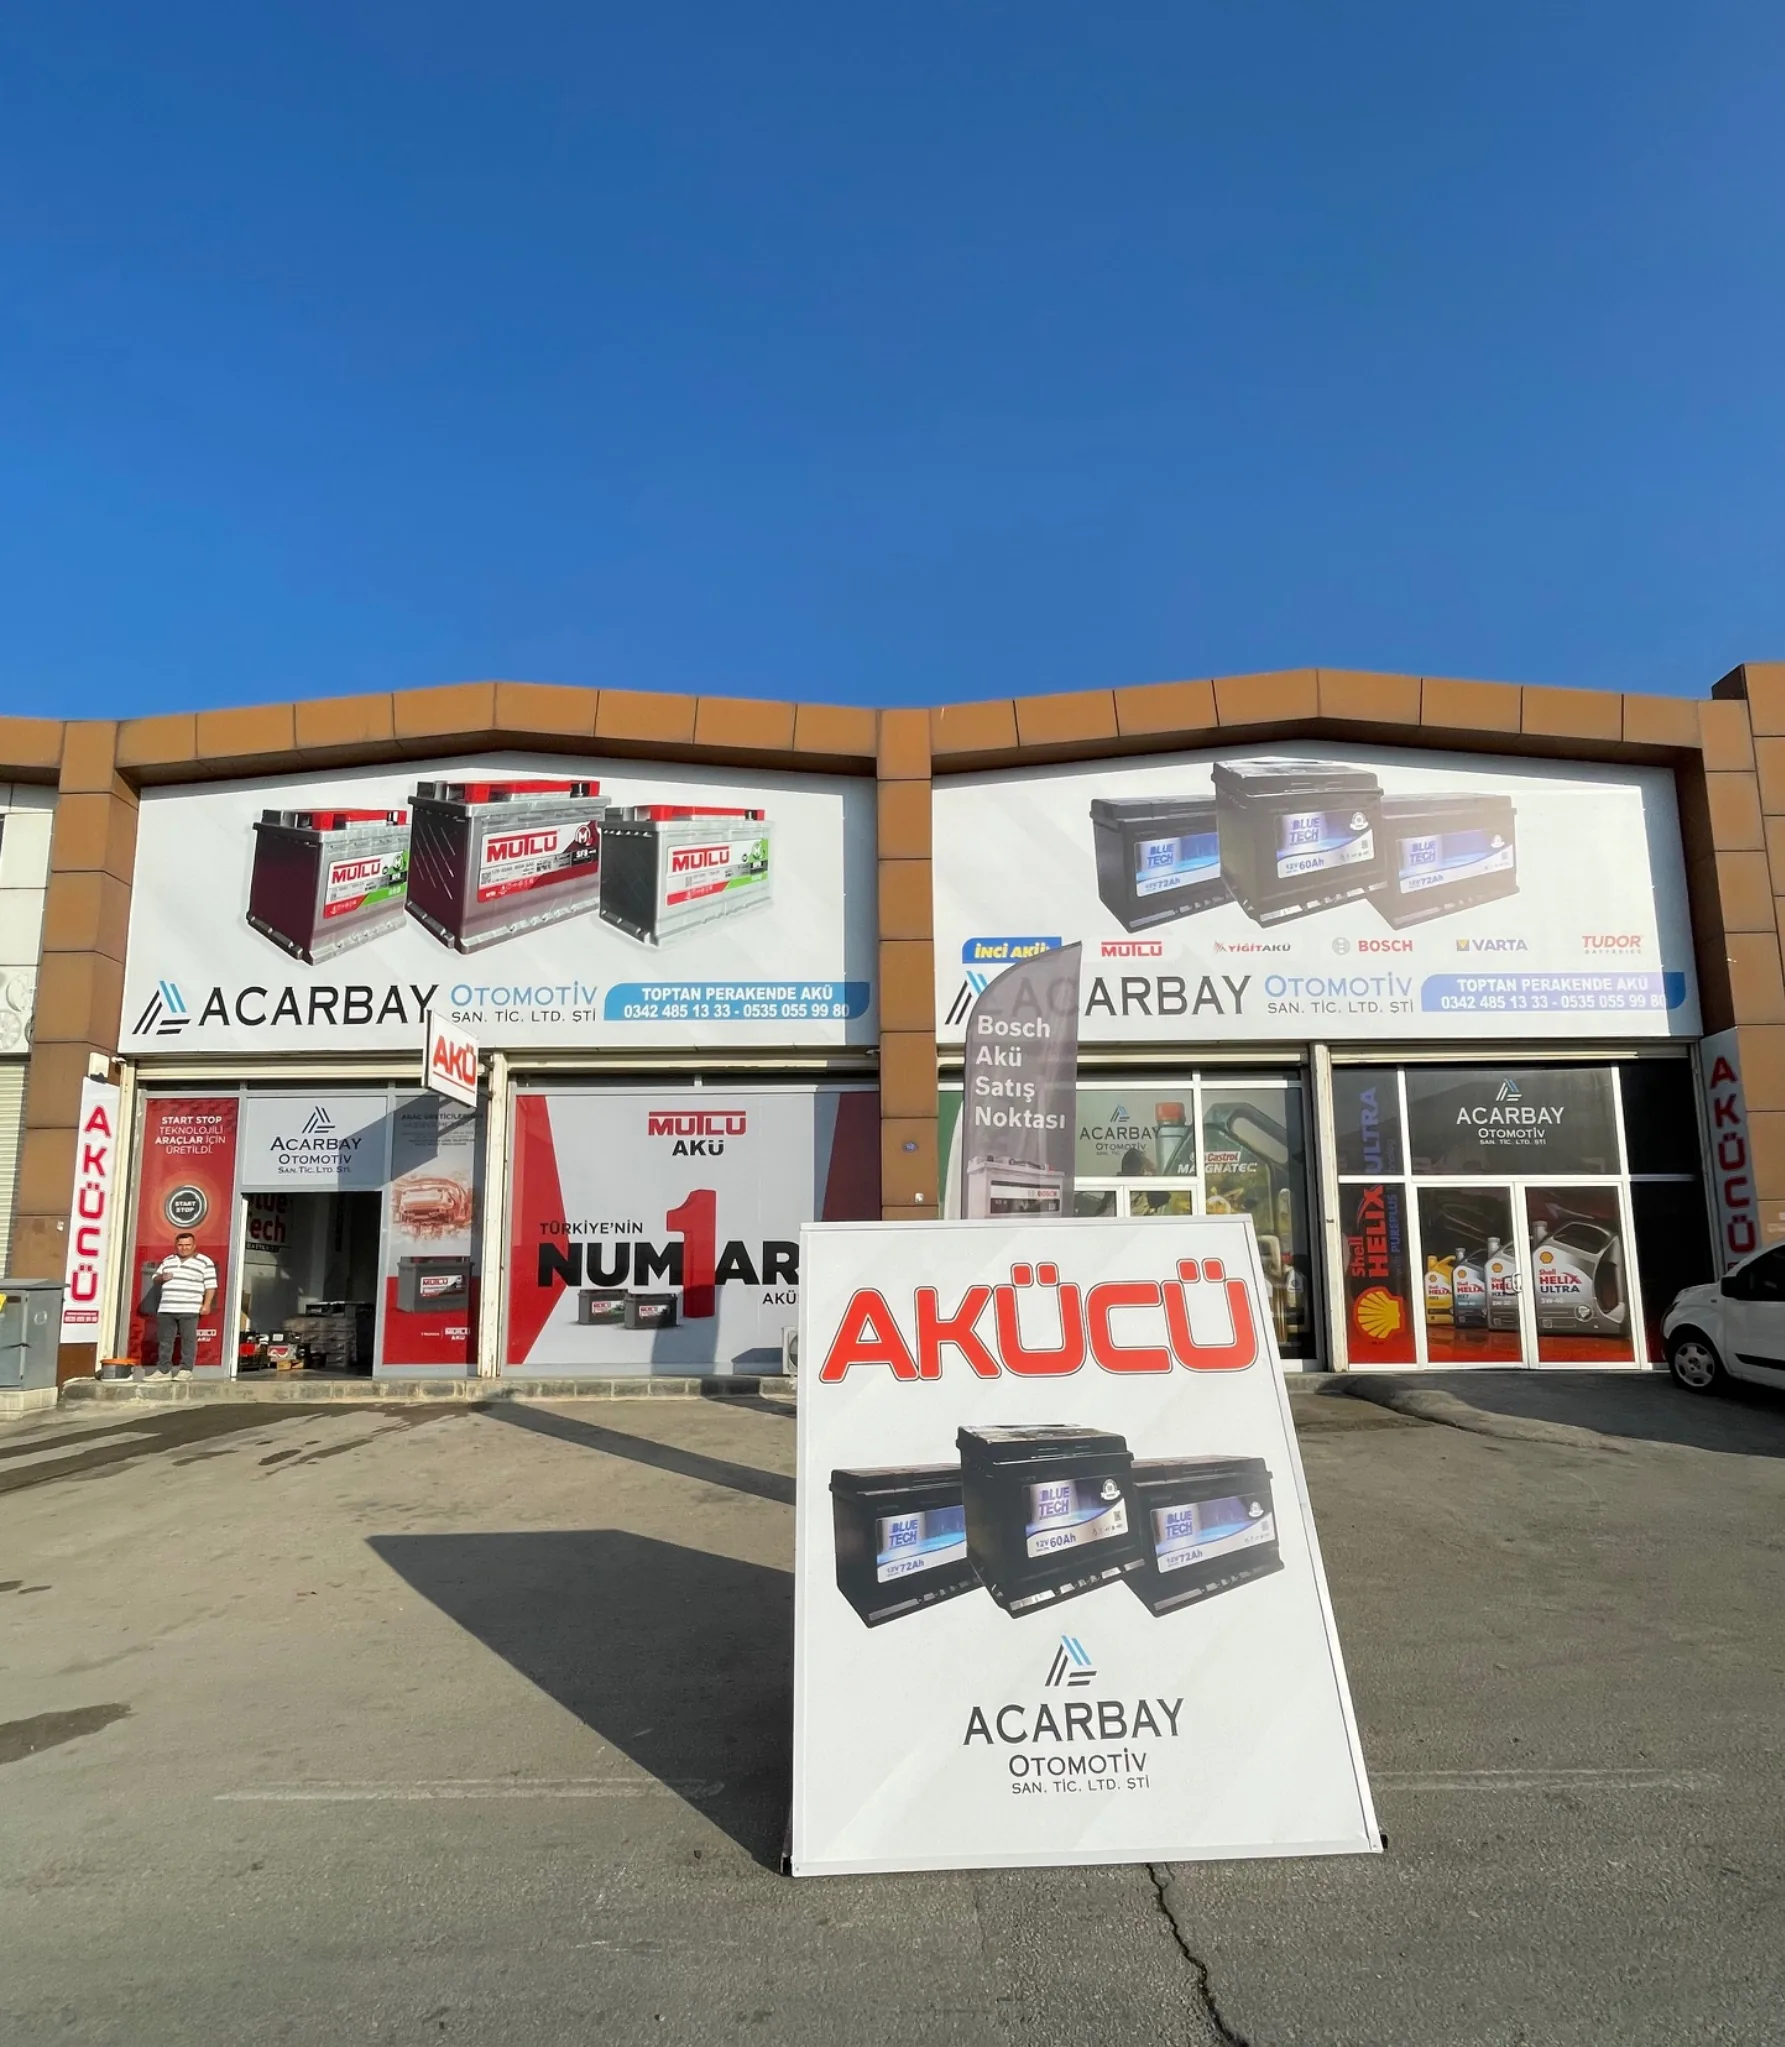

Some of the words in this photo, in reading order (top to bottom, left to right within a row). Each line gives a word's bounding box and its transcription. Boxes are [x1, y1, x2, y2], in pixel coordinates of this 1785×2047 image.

[1292, 817, 1320, 831] BLUE
[1289, 830, 1319, 843] TECH
[487, 831, 557, 862] MUTLU
[673, 846, 729, 872] MUTLU
[1299, 858, 1324, 871] 60Ah
[331, 858, 381, 884] MUTLU
[1101, 941, 1162, 957] MUTLU
[1358, 940, 1413, 953] BOSCH
[1472, 939, 1528, 951] VARTA
[1581, 935, 1641, 948] TUDOR
[1265, 972, 1412, 997] OTOMOTİV
[1457, 978, 1516, 992] TOPTAN
[1522, 977, 1612, 991] PERAKENDE
[1617, 976, 1648, 990] AKÜ
[642, 987, 701, 1001] TOPTAN
[706, 986, 796, 1001] PERAKENDE
[800, 985, 833, 1000] AKÜ
[198, 984, 439, 1026] ACARBAY
[451, 980, 598, 1006] OTOMOTİV
[1268, 1001, 1304, 1014] SAN.
[1311, 1000, 1341, 1013] TİC.
[1349, 1001, 1383, 1013] LTD.
[1441, 996, 1476, 1010] 0342
[1480, 996, 1505, 1010] 485
[1510, 996, 1526, 1009] 13
[1531, 996, 1549, 1009] 33
[1561, 995, 1595, 1009] 0535
[1599, 995, 1625, 1009] 055
[1629, 995, 1646, 1009] 99
[1650, 994, 1666, 1009] 80
[451, 1011, 487, 1023] SAN.
[495, 1009, 524, 1022] TİC.
[531, 1010, 565, 1022] LTD.
[624, 1004, 658, 1018] 0342
[663, 1004, 688, 1018] 485
[693, 1004, 709, 1018] 13
[714, 1004, 730, 1018] 33
[743, 1003, 777, 1017] 0535
[782, 1003, 807, 1017] 055
[811, 1003, 829, 1017] 99
[833, 1003, 849, 1017] 80
[978, 1015, 1051, 1038] Bosch
[433, 1035, 476, 1086] AKÜ
[976, 1045, 1022, 1067] Akü
[975, 1076, 1036, 1103] Satış
[162, 1116, 193, 1124] START
[196, 1116, 222, 1124] STOP
[975, 1106, 1066, 1129] Noktası
[1456, 1107, 1564, 1124] ACARBAY
[648, 1111, 746, 1136] MUTLU
[1079, 1126, 1160, 1140] ACARBAY
[1478, 1127, 1545, 1138] OTOMOTİV
[155, 1136, 203, 1145] ARAÇLAR
[270, 1136, 362, 1151] ACARBAY
[672, 1139, 725, 1156] AKÜ
[278, 1152, 352, 1165] OTOMOTİV
[1207, 1153, 1238, 1161] Castrol
[1710, 1056, 1757, 1254] AKÜCÜ
[70, 1106, 111, 1301] AKÜCÜ
[1357, 1185, 1390, 1278] HELIX
[1346, 1236, 1366, 1278] Shell
[1539, 1272, 1582, 1284] HELIX
[1540, 1285, 1580, 1293] ULTRA
[819, 1257, 1258, 1384] AKÜCÜ
[1041, 1487, 1070, 1501] BLUE
[1039, 1500, 1069, 1516] TECH
[1167, 1510, 1192, 1523] BLUE
[892, 1520, 918, 1532] BLUE
[1166, 1521, 1192, 1537] TECH
[889, 1531, 917, 1546] TECH
[1050, 1533, 1076, 1547] 60Ah
[1180, 1549, 1203, 1562] 72Ah
[900, 1559, 925, 1573] 72Ah
[963, 1698, 1184, 1745] ACARBAY
[1009, 1748, 1147, 1777] OTOMOTİV
[1012, 1782, 1047, 1794] SAN.
[1053, 1779, 1082, 1793] TİC.
[1088, 1779, 1120, 1791] LTD.
